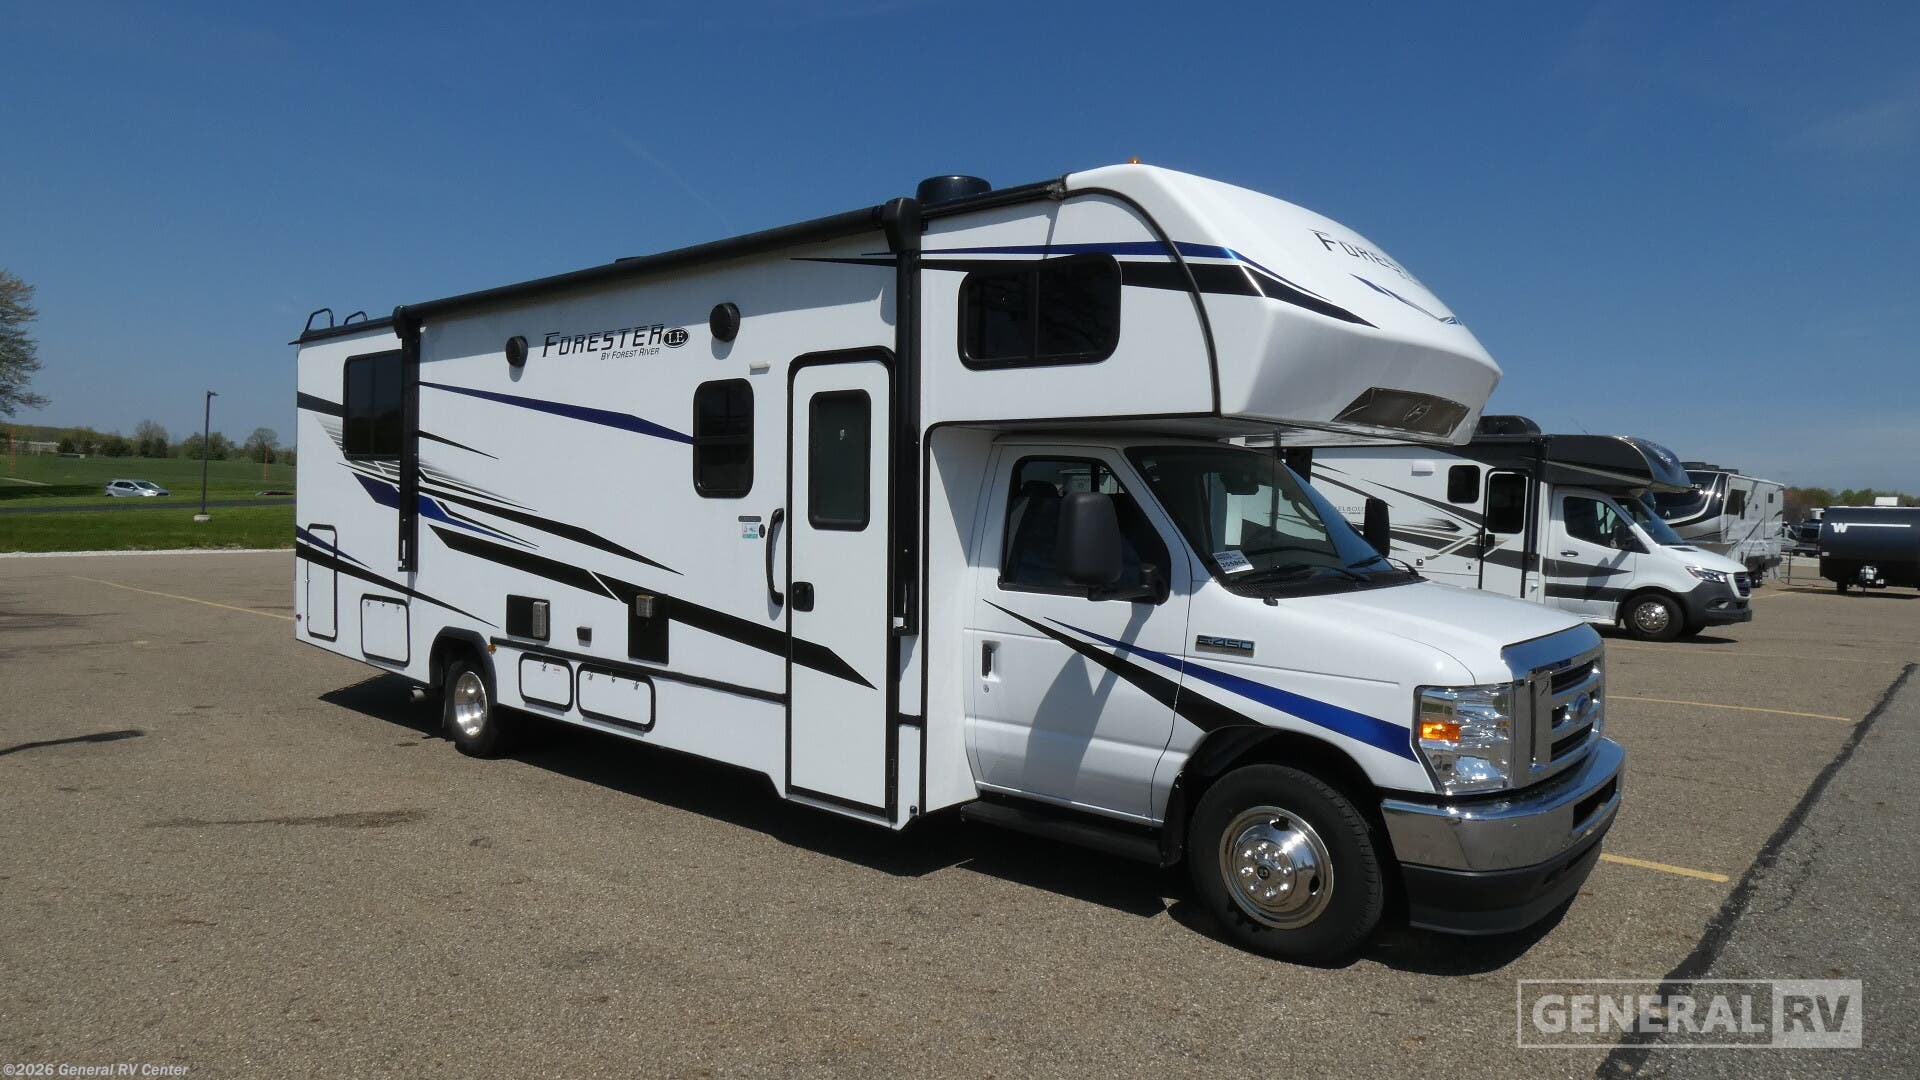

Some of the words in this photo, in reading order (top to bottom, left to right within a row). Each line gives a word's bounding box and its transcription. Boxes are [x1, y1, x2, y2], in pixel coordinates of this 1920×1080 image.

[542, 323, 665, 358] FORESTER
[600, 352, 611, 360] BY
[612, 349, 638, 359] FOREST
[639, 347, 660, 356] RIVER
[1335, 504, 1364, 512] ELBOU
